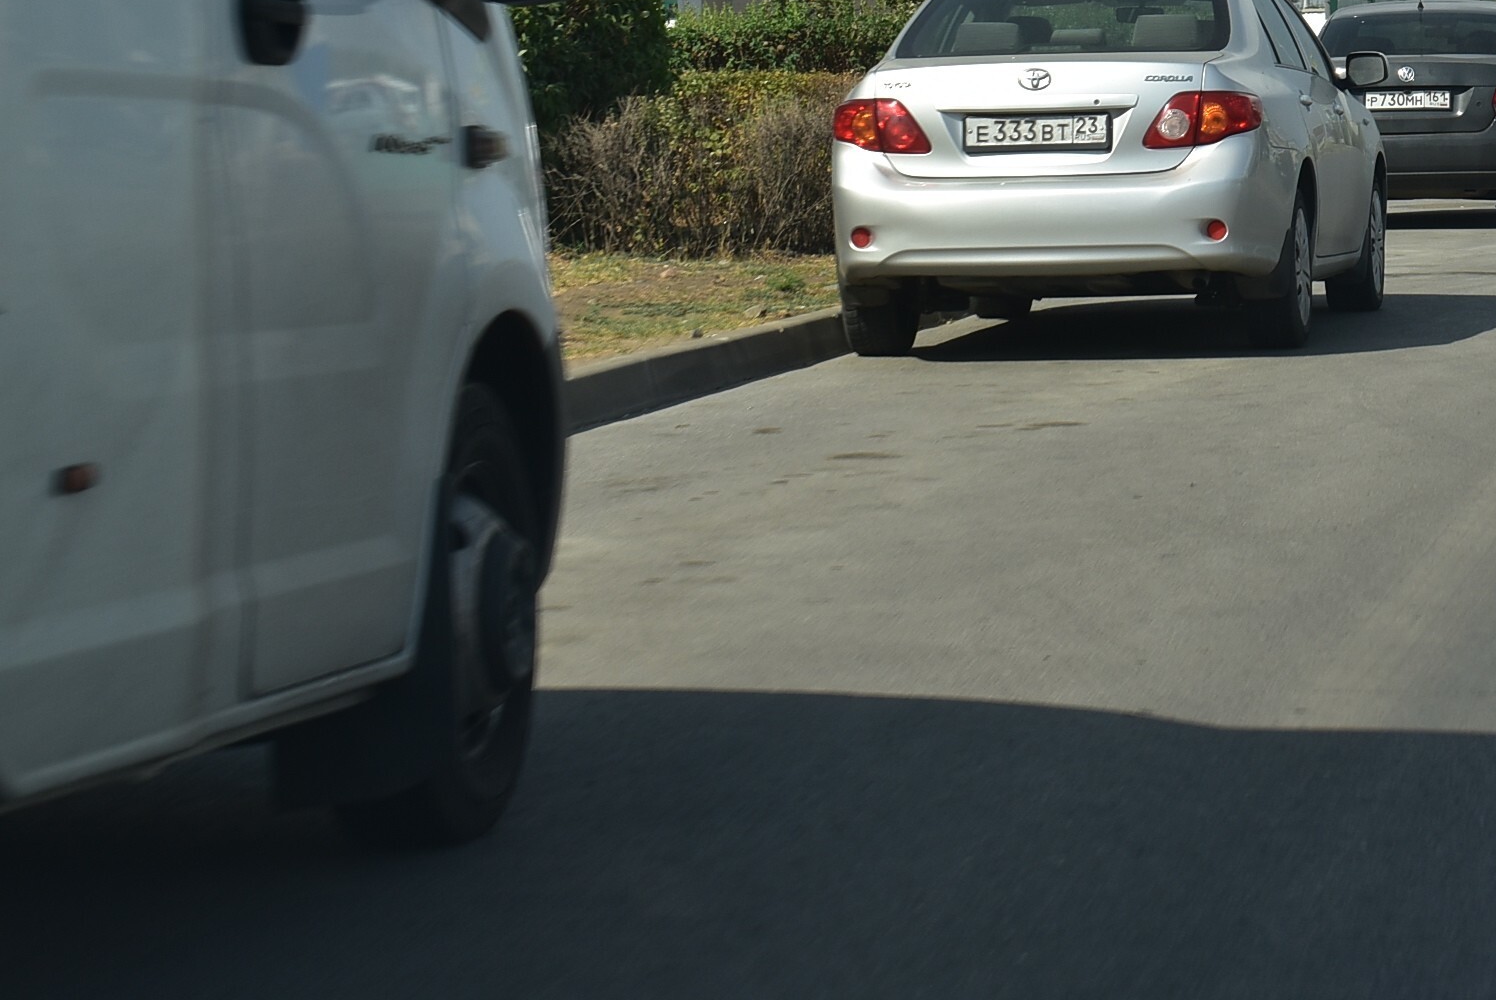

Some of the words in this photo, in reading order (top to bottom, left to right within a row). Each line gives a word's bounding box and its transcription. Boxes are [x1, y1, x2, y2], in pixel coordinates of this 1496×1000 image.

[1144, 75, 1194, 83] COROLLA
[1426, 92, 1446, 102] 161
[976, 120, 1069, 142] Е333ВТ
[1076, 115, 1099, 134] 23
